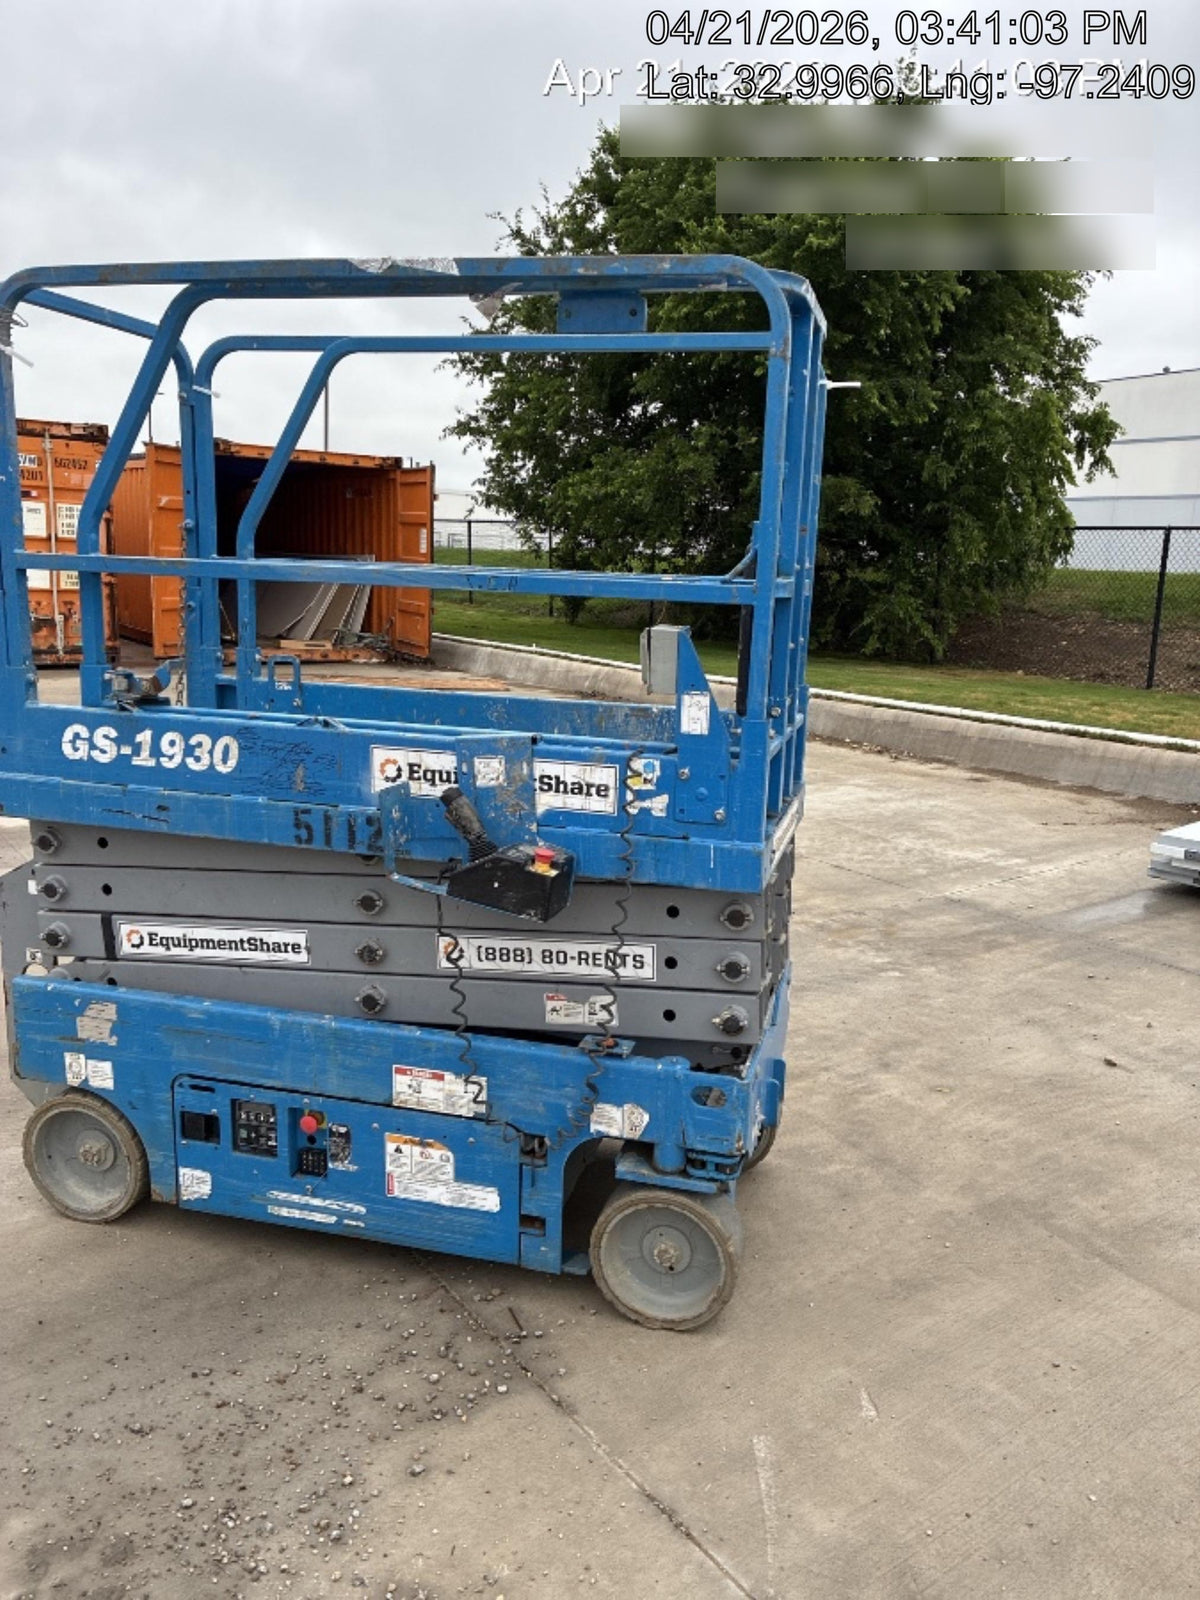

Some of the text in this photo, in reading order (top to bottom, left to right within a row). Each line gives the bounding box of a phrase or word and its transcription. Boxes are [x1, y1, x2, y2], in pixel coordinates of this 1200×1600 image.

[61, 723, 239, 774] GS-1930
[147, 932, 302, 954] EquipmentShare
[541, 948, 645, 970] 80-RENTS
